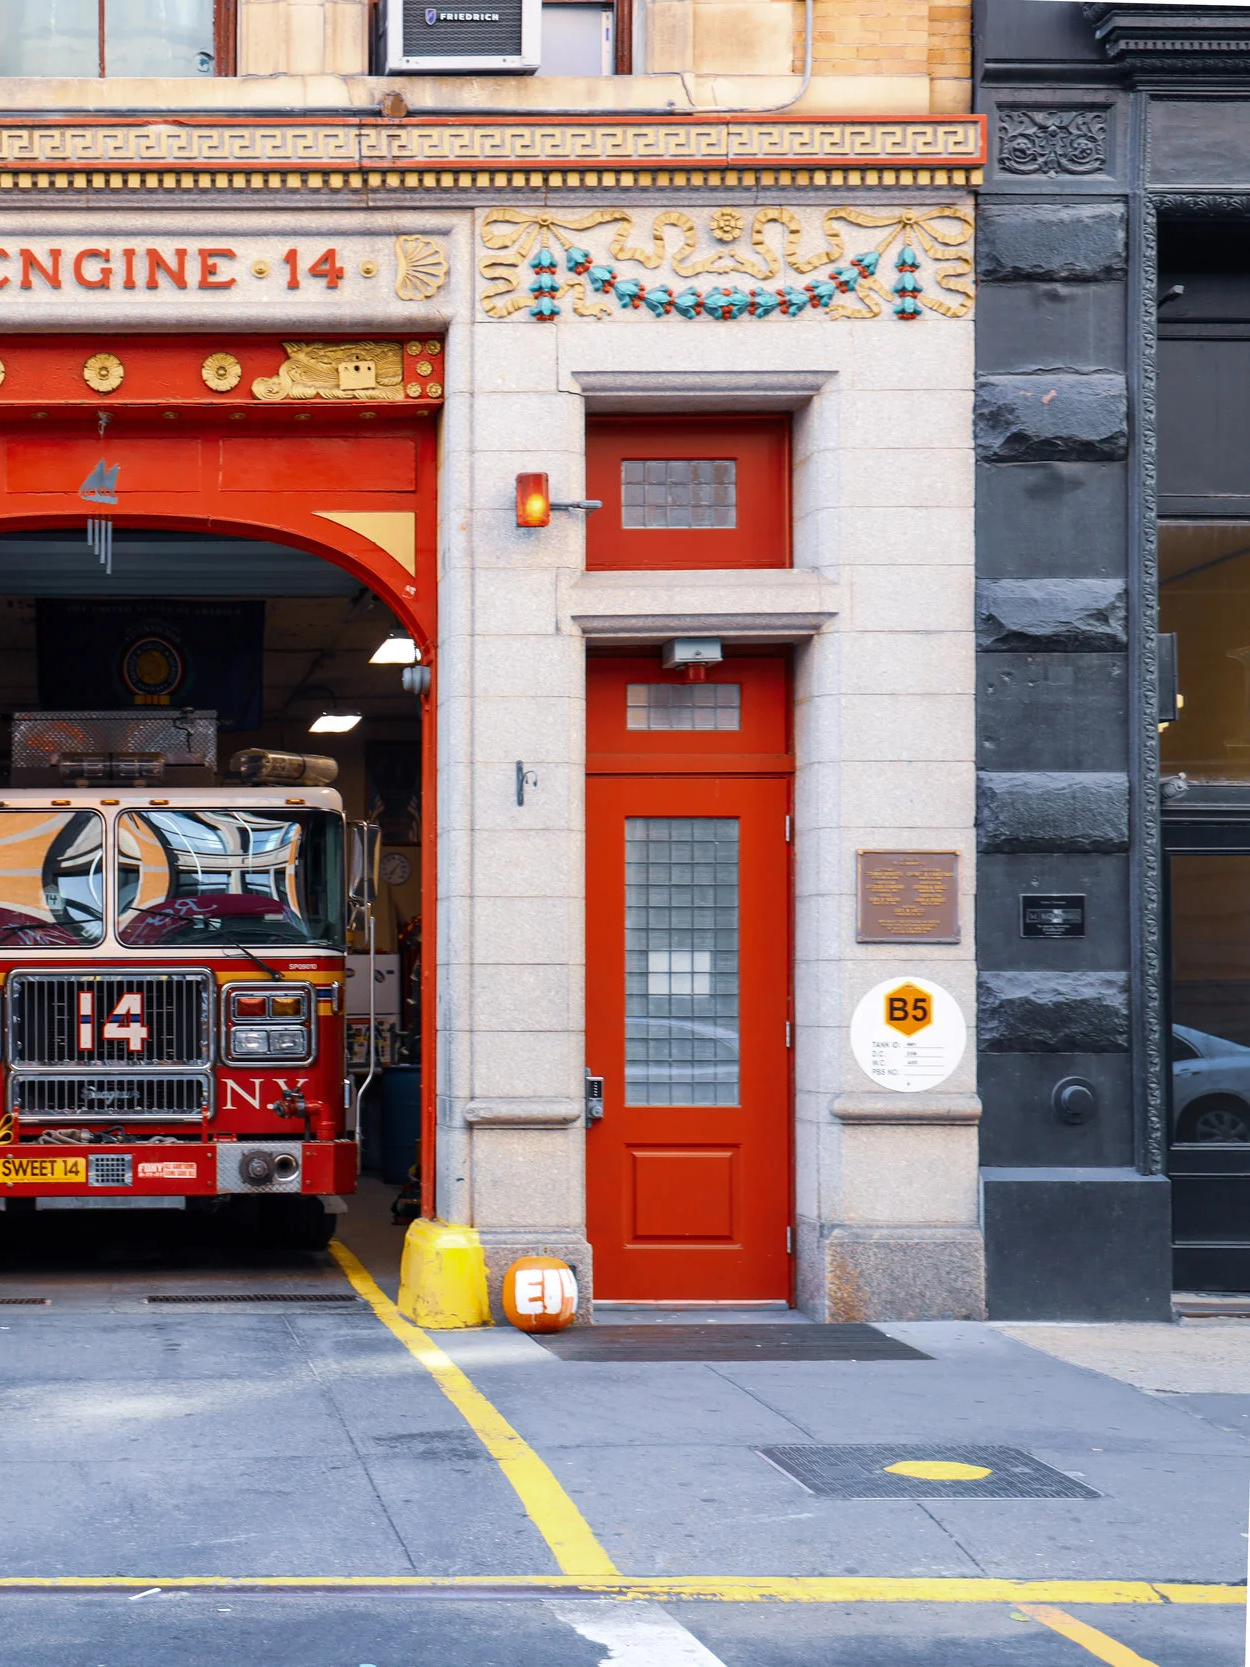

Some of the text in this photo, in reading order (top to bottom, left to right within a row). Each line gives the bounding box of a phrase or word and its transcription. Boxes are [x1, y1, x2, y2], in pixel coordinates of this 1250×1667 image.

[440, 13, 500, 21] FRIEDRICH
[283, 248, 345, 289] 14
[78, 991, 148, 1053] 14
[889, 997, 928, 1022] B5
[2, 1159, 80, 1176] SWEET 14
